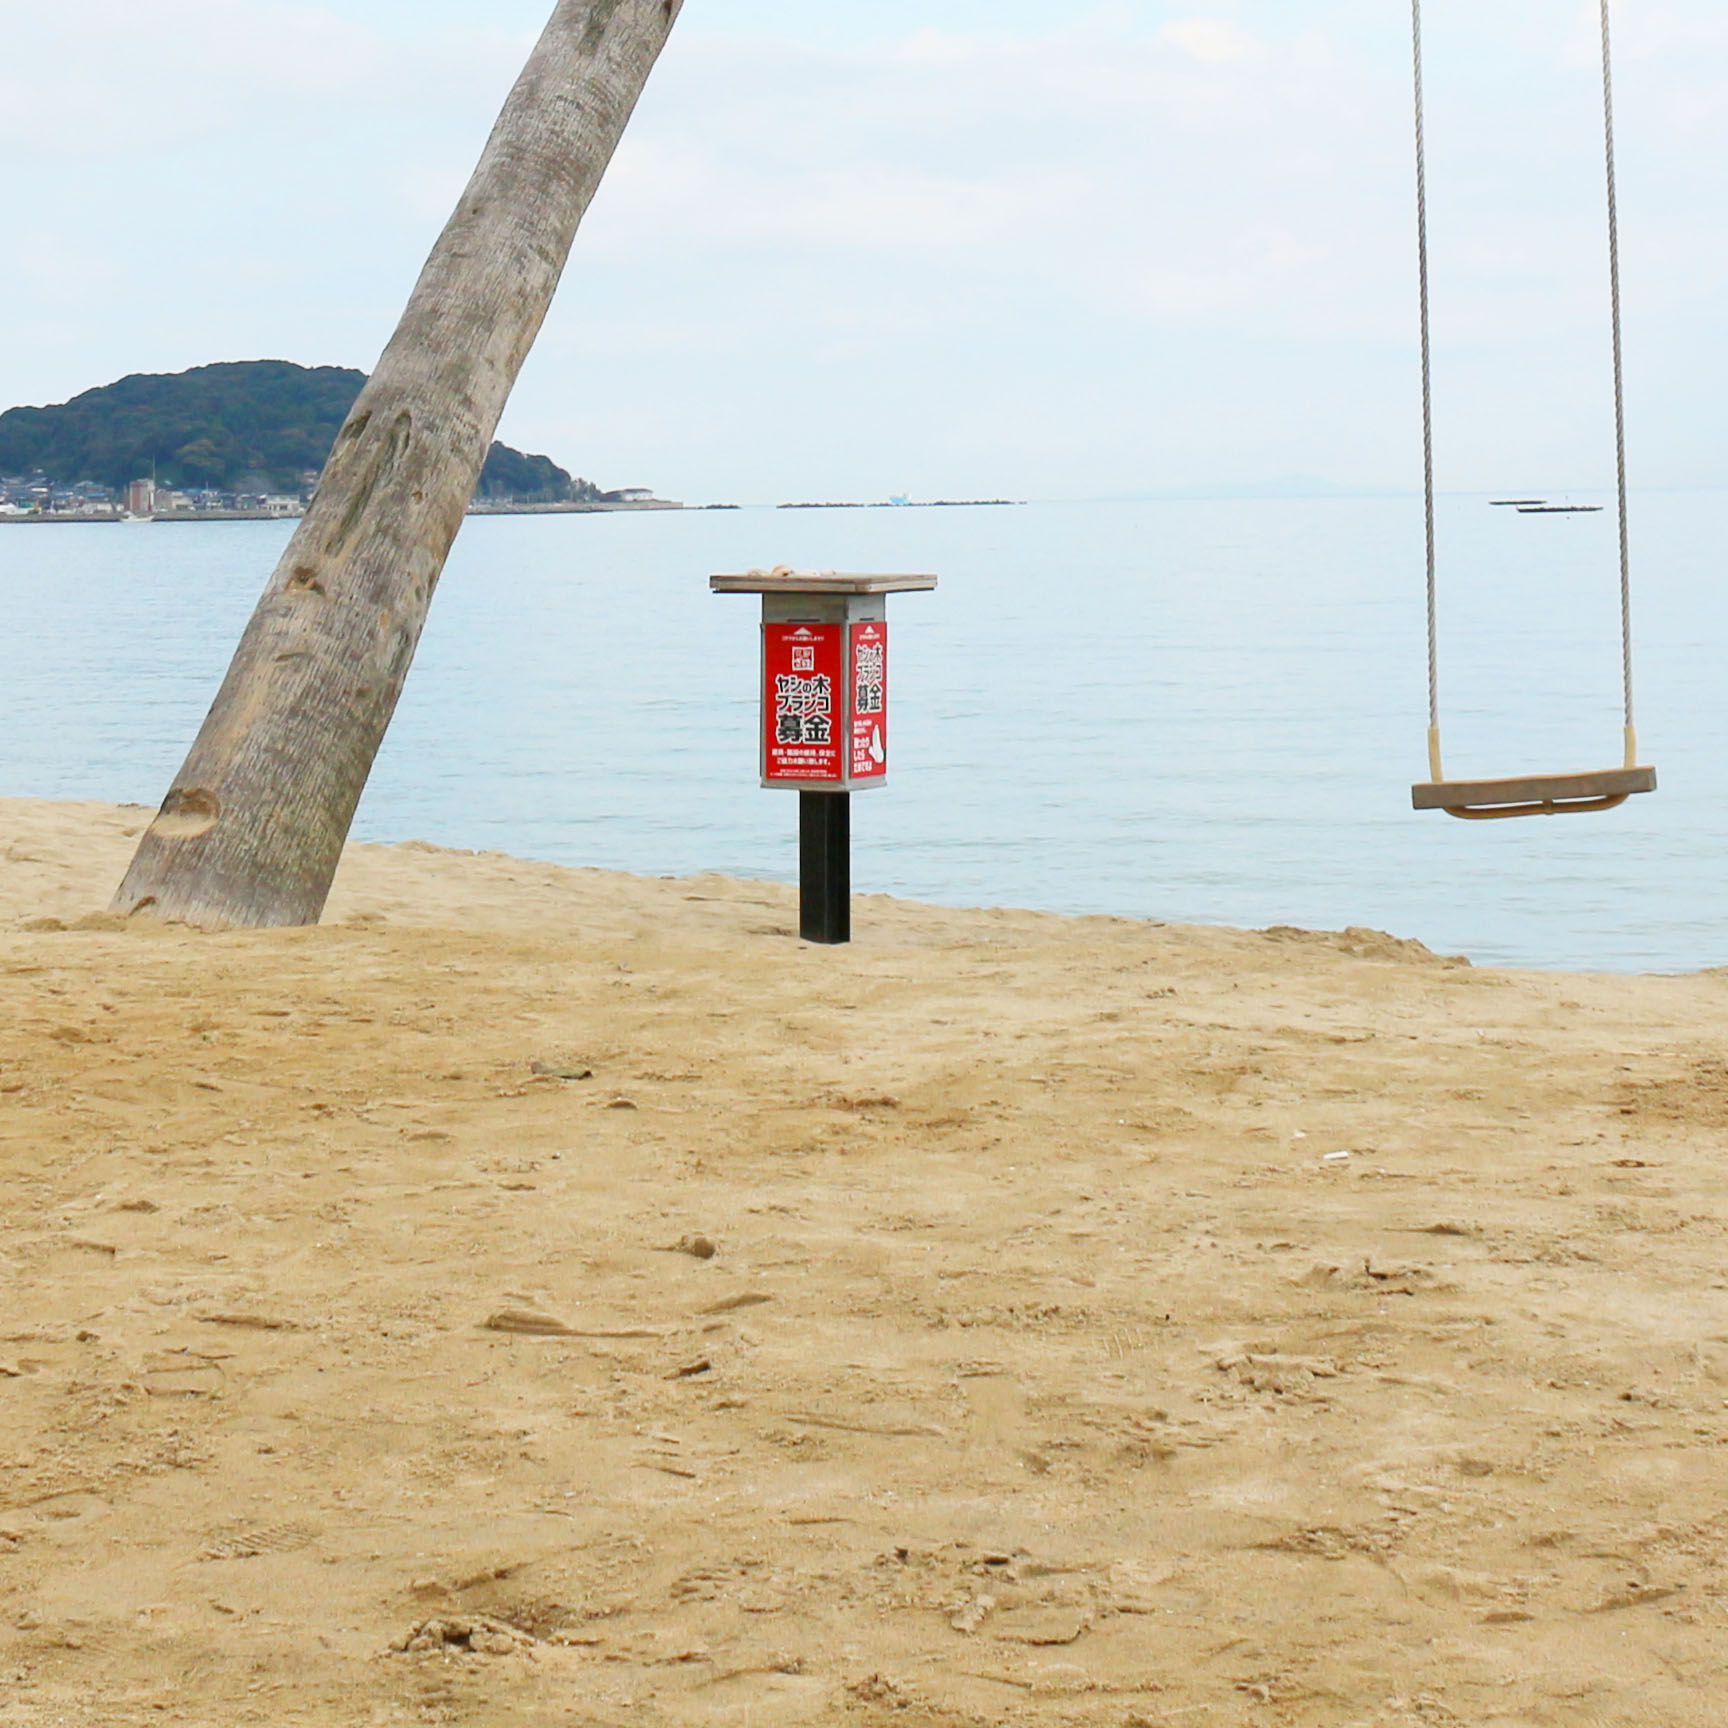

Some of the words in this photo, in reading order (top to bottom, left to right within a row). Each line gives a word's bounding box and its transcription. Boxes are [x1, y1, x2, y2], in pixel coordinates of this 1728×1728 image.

[776, 674, 830, 694] ヤシの木
[857, 682, 882, 714] 募金
[777, 713, 831, 743] 募金
